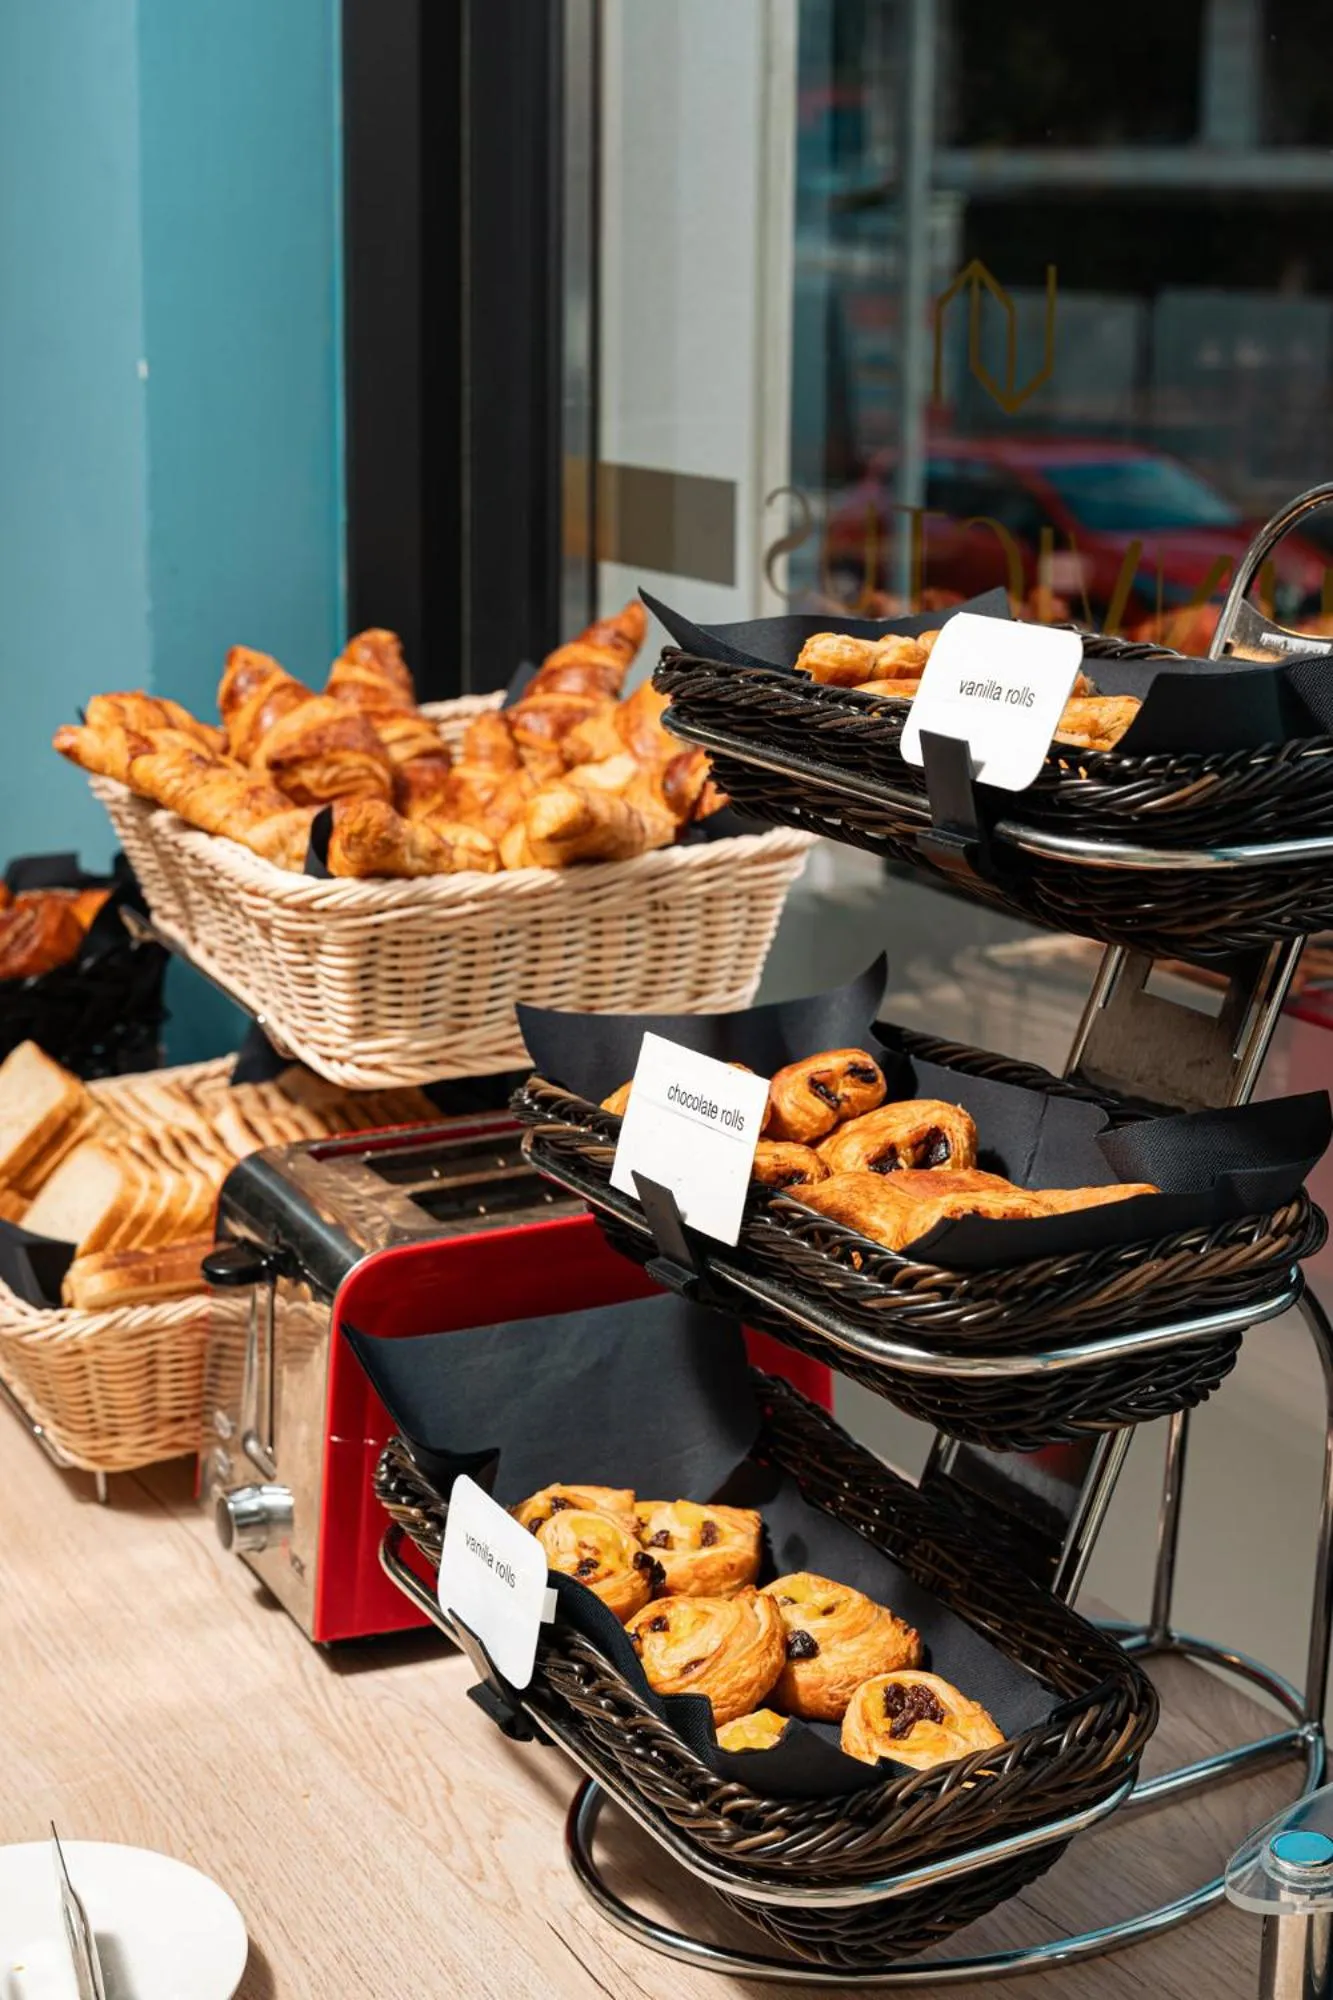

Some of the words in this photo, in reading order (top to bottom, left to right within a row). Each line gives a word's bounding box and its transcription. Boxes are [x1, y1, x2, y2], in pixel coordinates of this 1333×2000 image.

[959, 678, 1002, 701] vanilla
[1005, 686, 1036, 708] rolls
[667, 1083, 718, 1119] chocolate
[720, 1107, 745, 1131] rolls
[465, 1532, 493, 1568] vanilla
[495, 1560, 516, 1588] rolls
